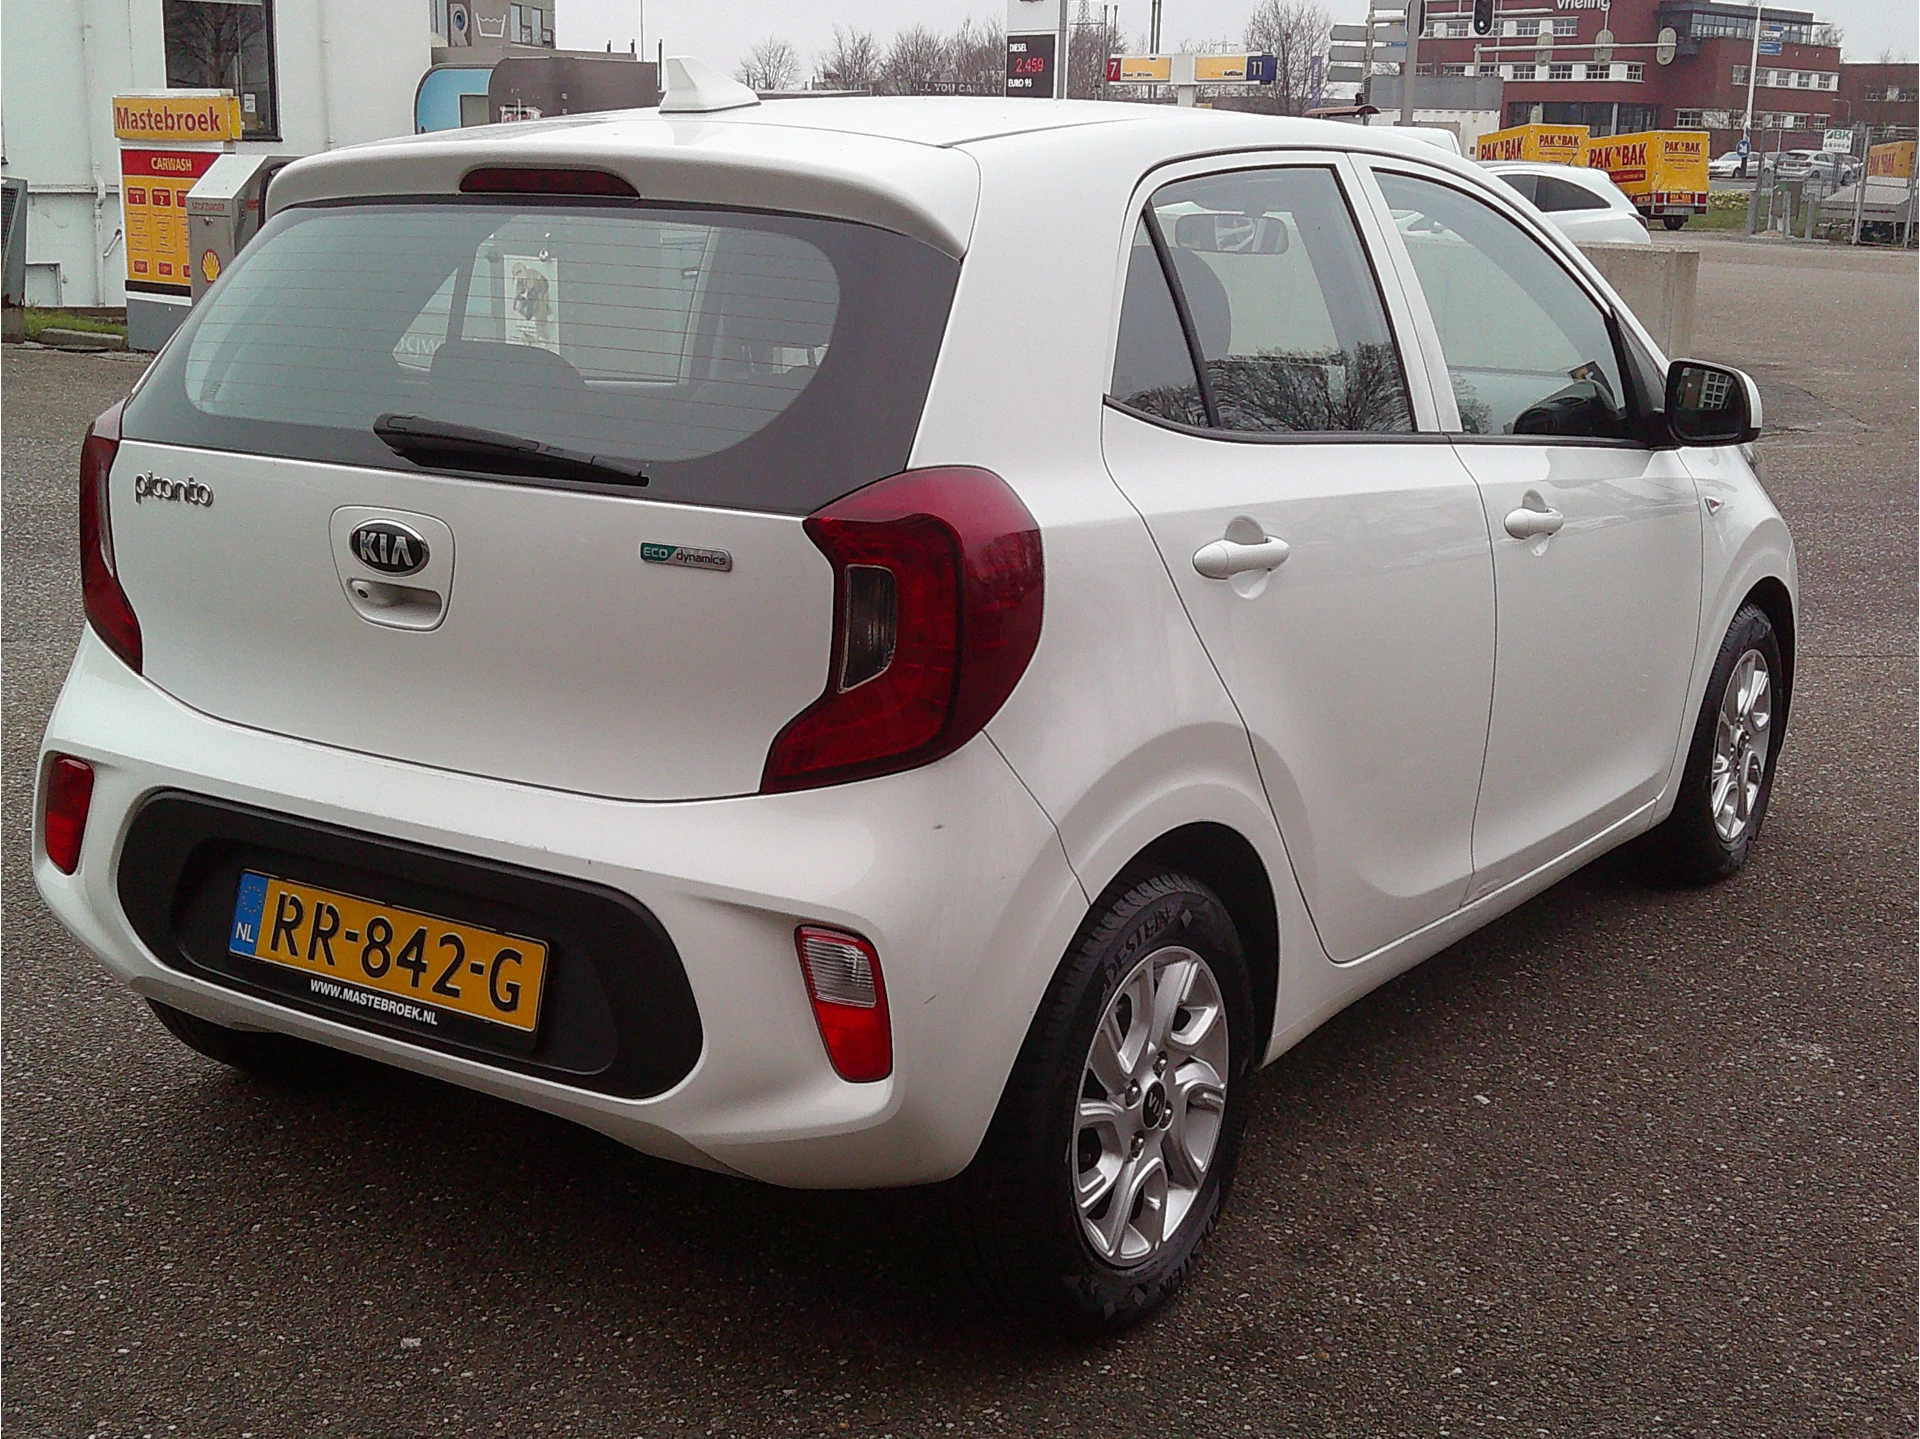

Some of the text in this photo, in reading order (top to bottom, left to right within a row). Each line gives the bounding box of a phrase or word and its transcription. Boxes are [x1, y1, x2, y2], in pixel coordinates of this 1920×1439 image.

[1009, 43, 1027, 52] DIESEL
[1015, 57, 1044, 72] 2.459
[1109, 61, 1118, 77] 7
[1251, 61, 1263, 76] 11
[934, 83, 956, 93] YOU
[1008, 78, 1032, 87] EURO 95
[116, 106, 221, 132] Mastebroek
[1539, 135, 1555, 146] PAK
[1562, 136, 1580, 146] BAK
[1834, 131, 1851, 140] BK
[1481, 142, 1499, 160] PAK
[1504, 136, 1524, 160] BAK
[1664, 141, 1680, 152] PAK
[1685, 142, 1701, 153] BAK
[1590, 147, 1613, 168] PAK
[1622, 142, 1647, 166] BAK
[151, 157, 192, 171] CARWASH
[159, 195, 165, 205] 2
[135, 470, 214, 507] picanto
[360, 530, 414, 567] KIA
[643, 547, 726, 566] ECO dynamics
[235, 921, 254, 944] NL
[270, 891, 523, 1013] RR-842-G
[310, 979, 438, 1026] WWW.MASTEBROEK.NL
